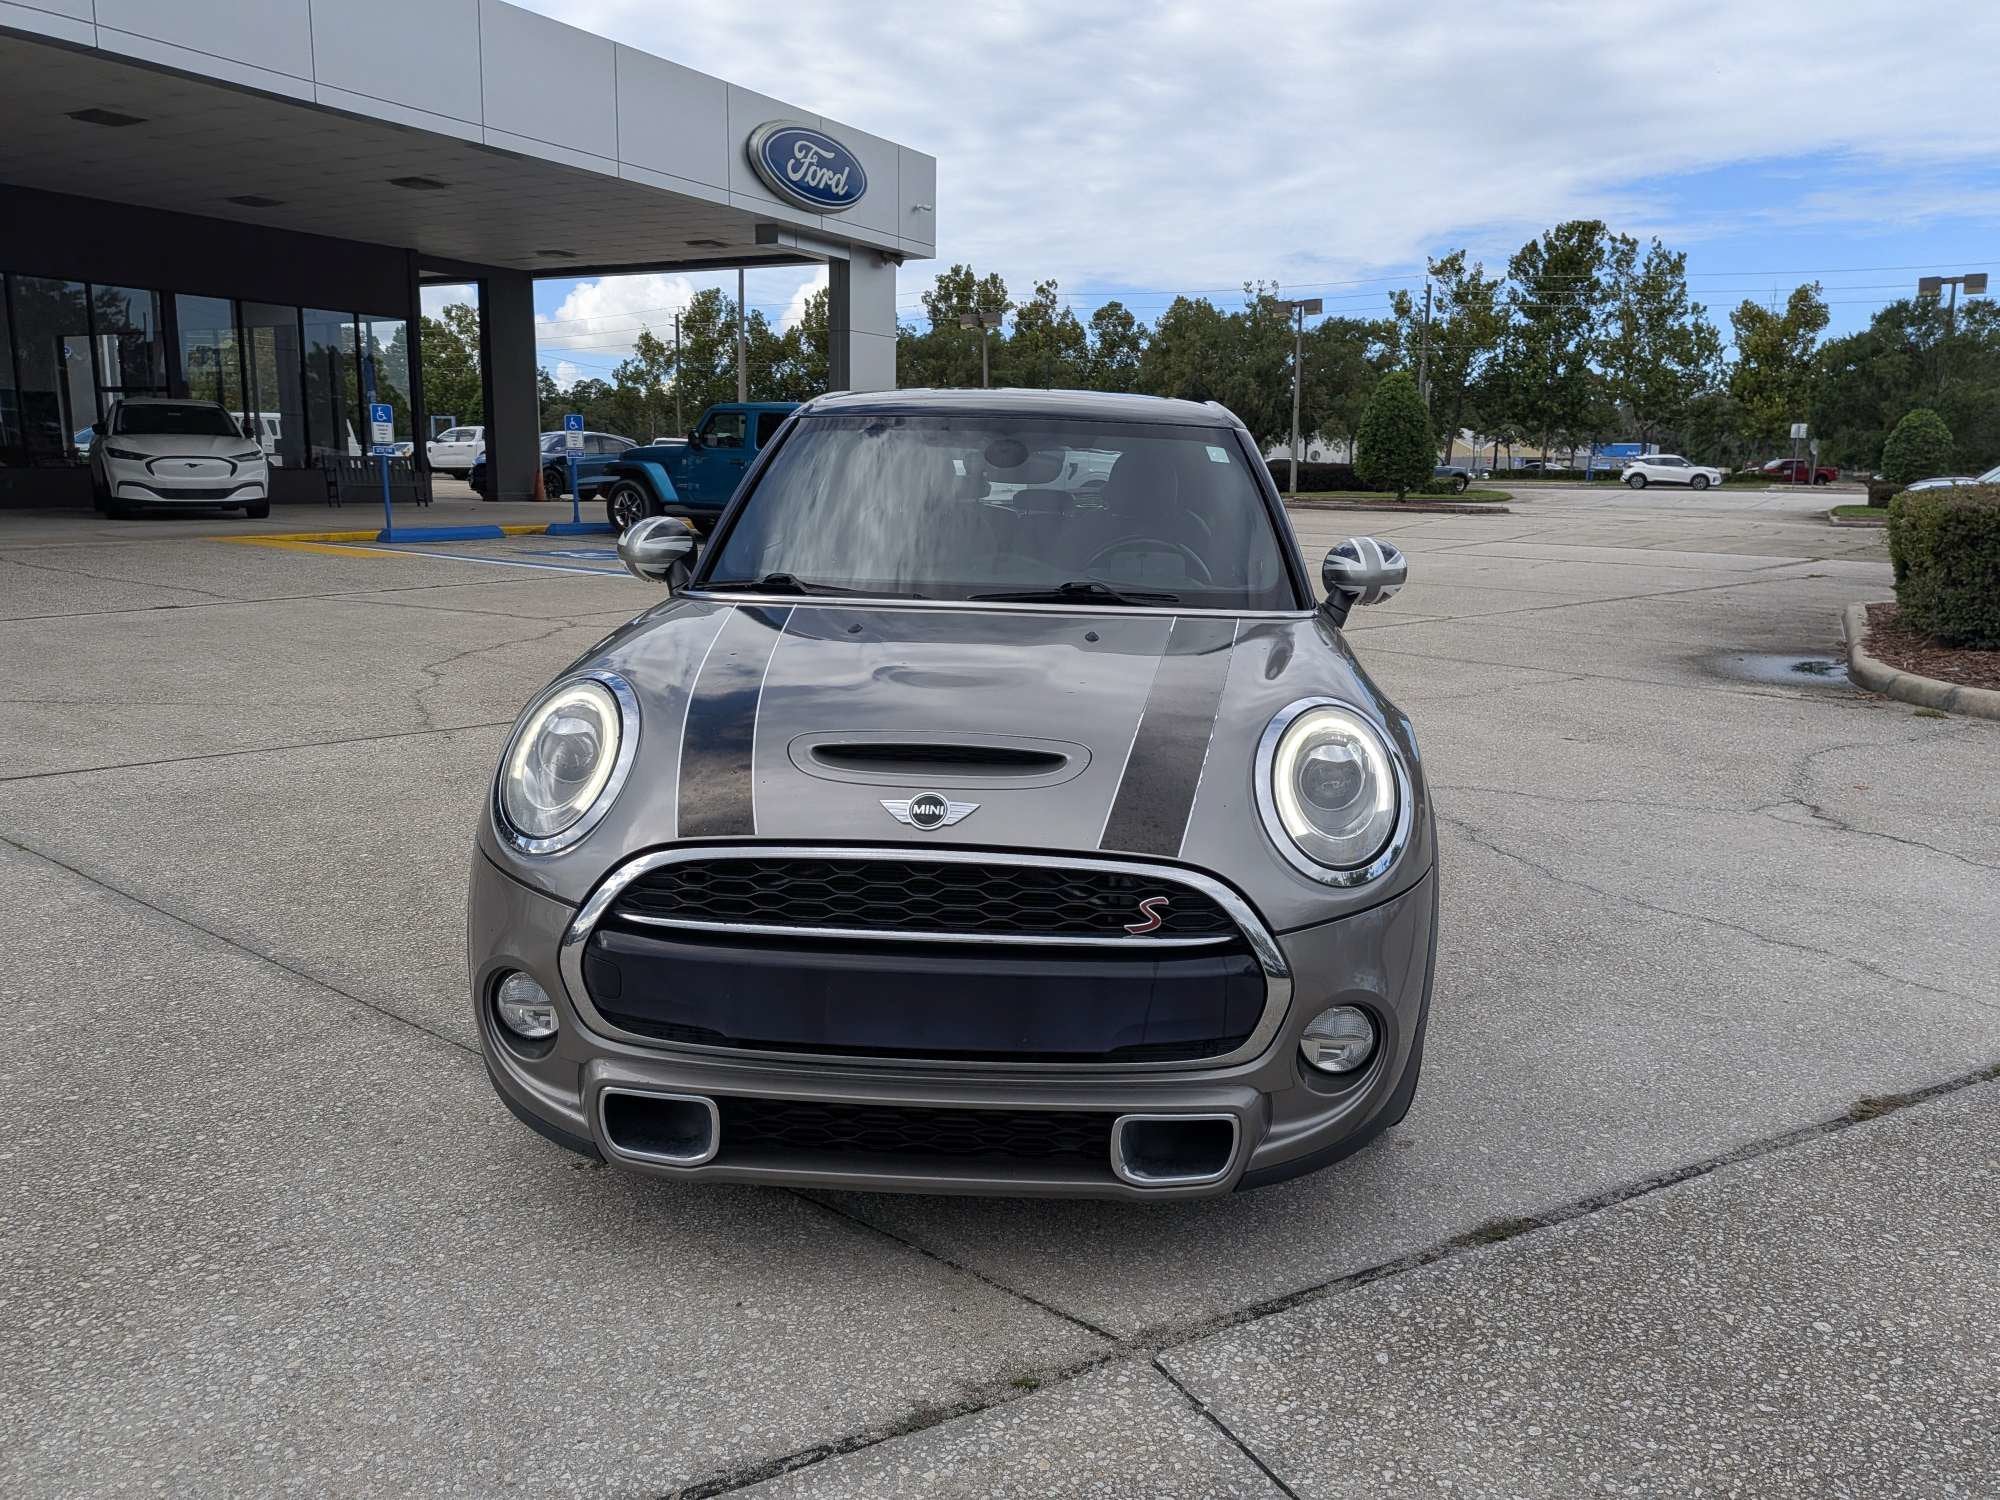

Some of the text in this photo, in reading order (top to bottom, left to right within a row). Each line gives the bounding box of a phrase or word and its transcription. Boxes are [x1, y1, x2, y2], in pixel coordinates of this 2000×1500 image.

[787, 140, 849, 195] Ford
[912, 804, 945, 816] MINI
[1123, 896, 1169, 934] S
